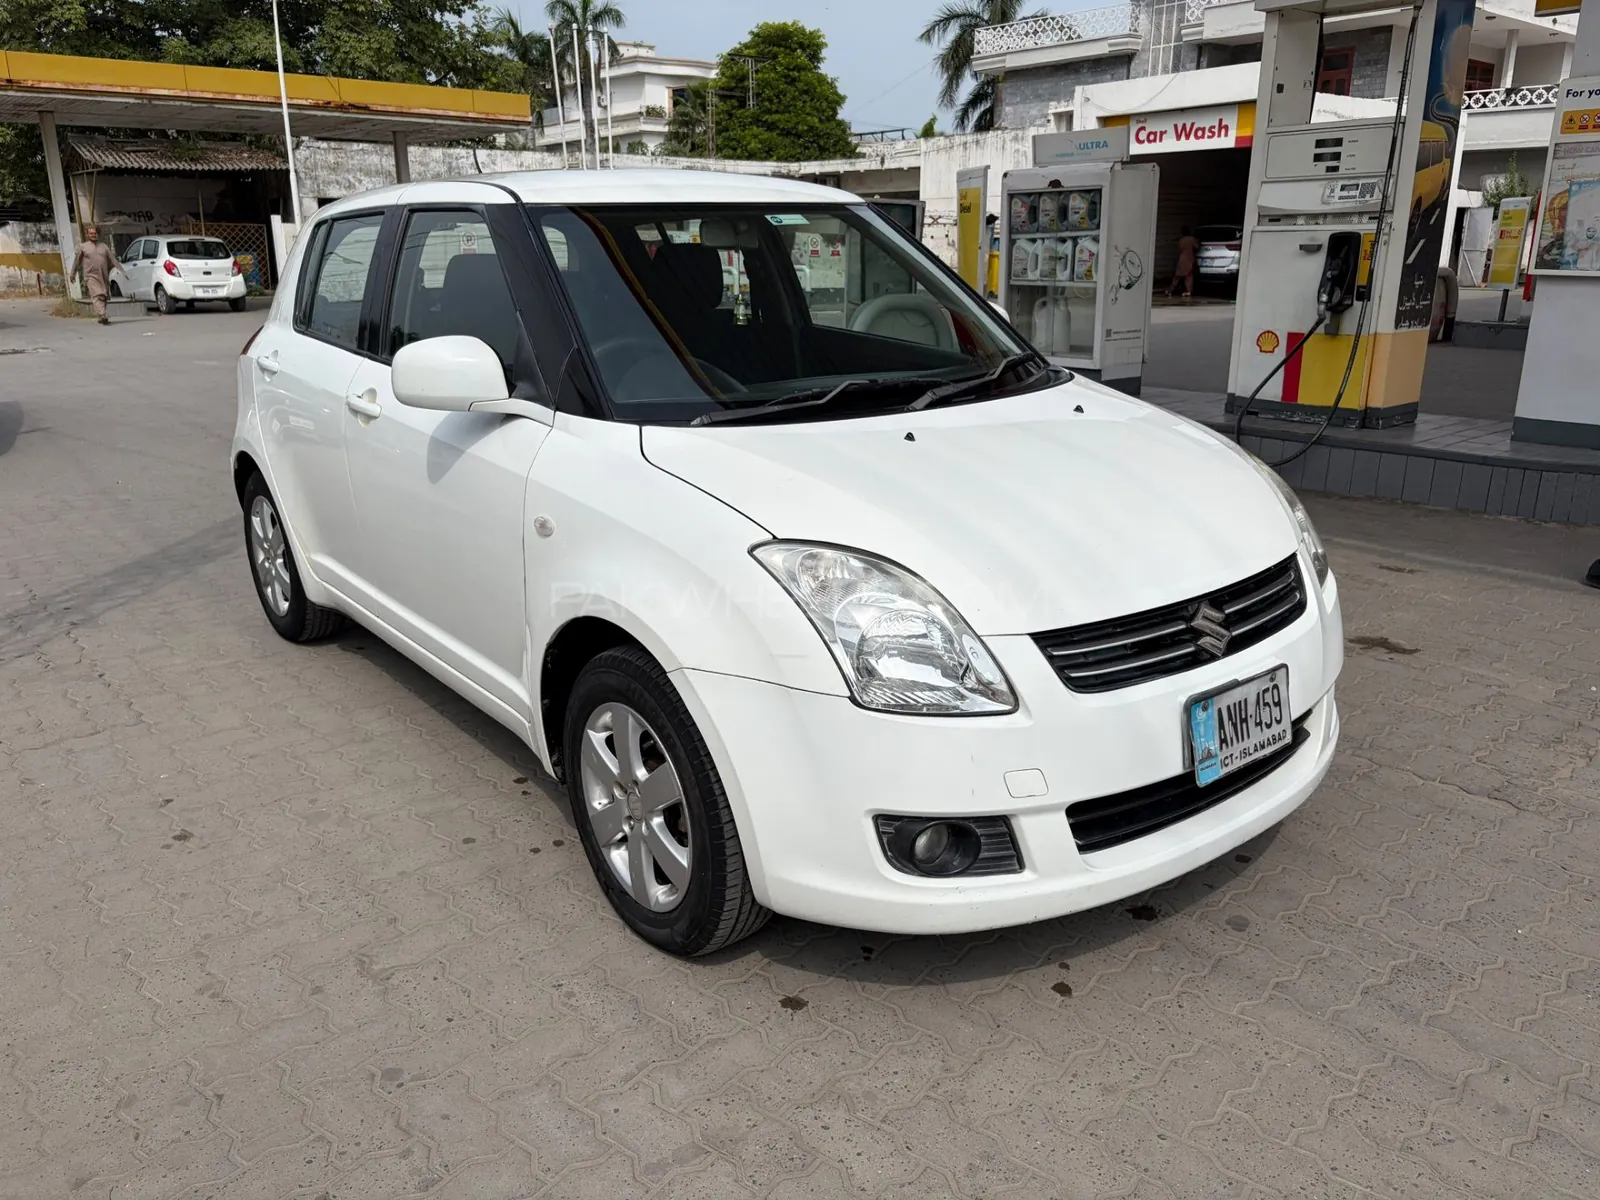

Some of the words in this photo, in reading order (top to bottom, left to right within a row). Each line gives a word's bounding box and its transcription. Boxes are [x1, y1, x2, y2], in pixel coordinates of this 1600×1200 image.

[1565, 88, 1586, 99] For
[1134, 125, 1168, 145] Car
[1173, 117, 1230, 142] Wash
[1078, 140, 1109, 151] ULTRA
[1219, 728, 1288, 770] ICT-ISLAMABAD
